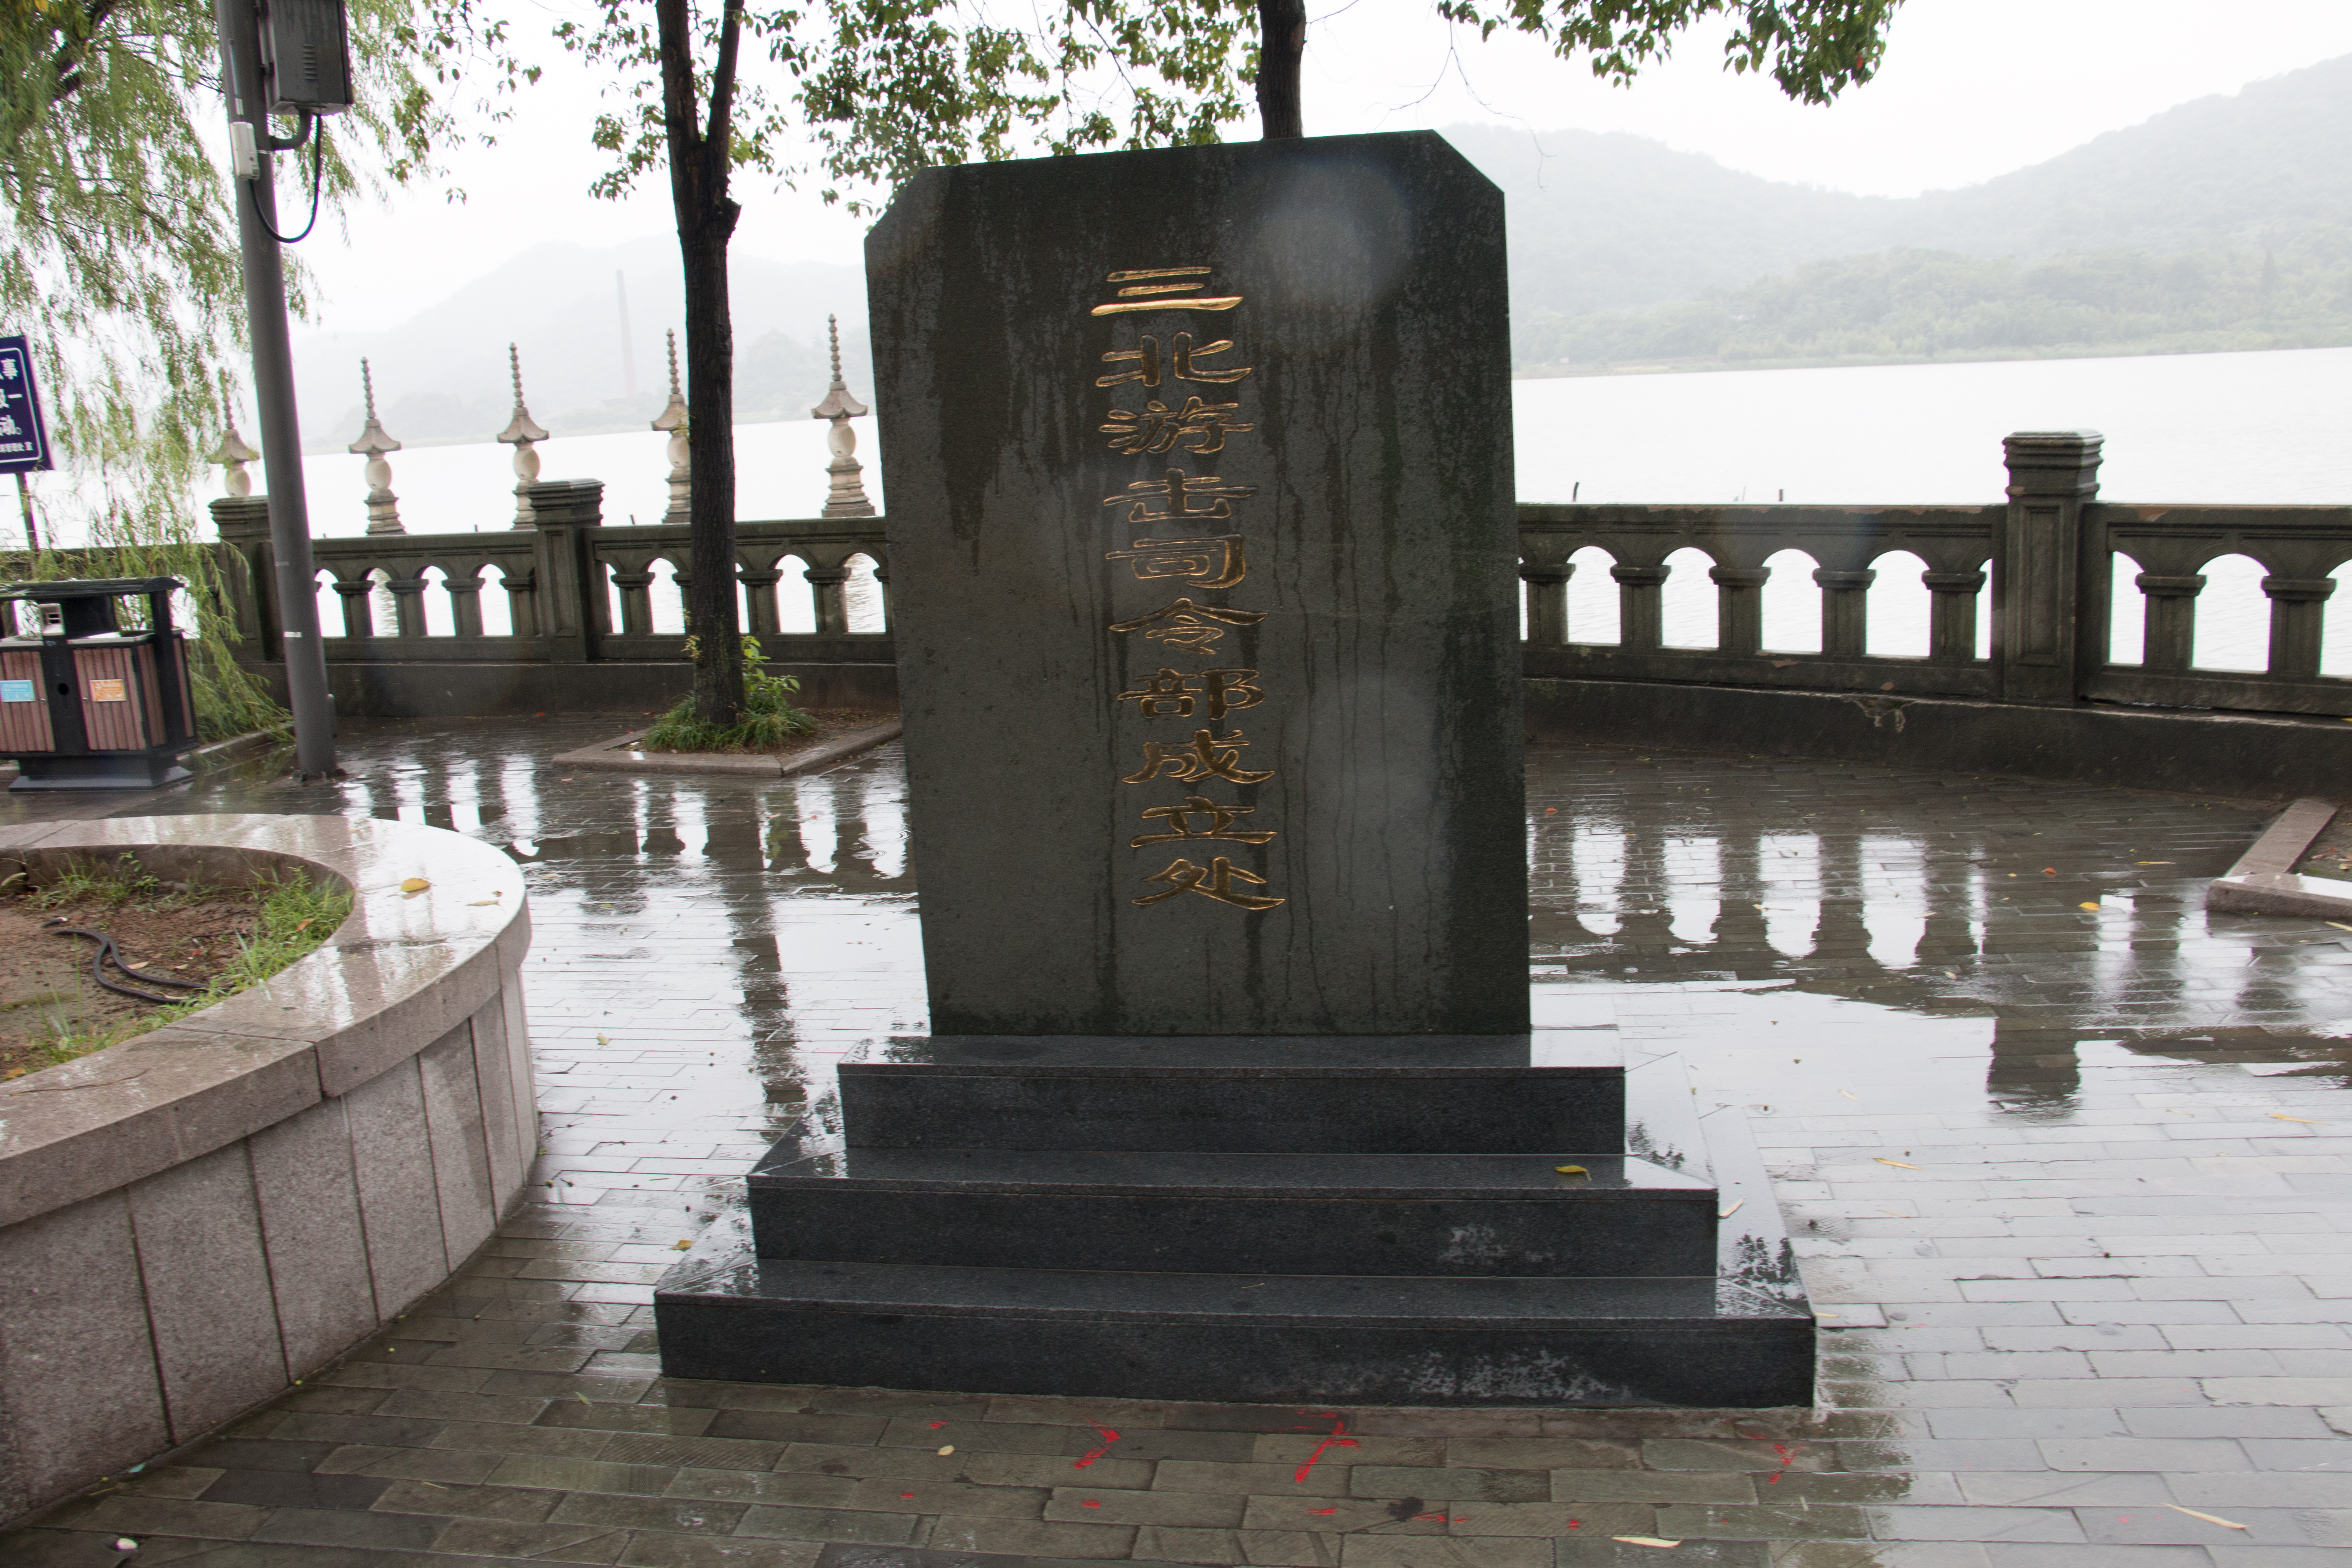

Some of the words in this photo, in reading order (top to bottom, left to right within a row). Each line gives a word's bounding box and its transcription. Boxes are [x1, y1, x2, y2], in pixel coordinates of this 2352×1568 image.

[1091, 266, 1285, 910] 三北游击司令部成立处
